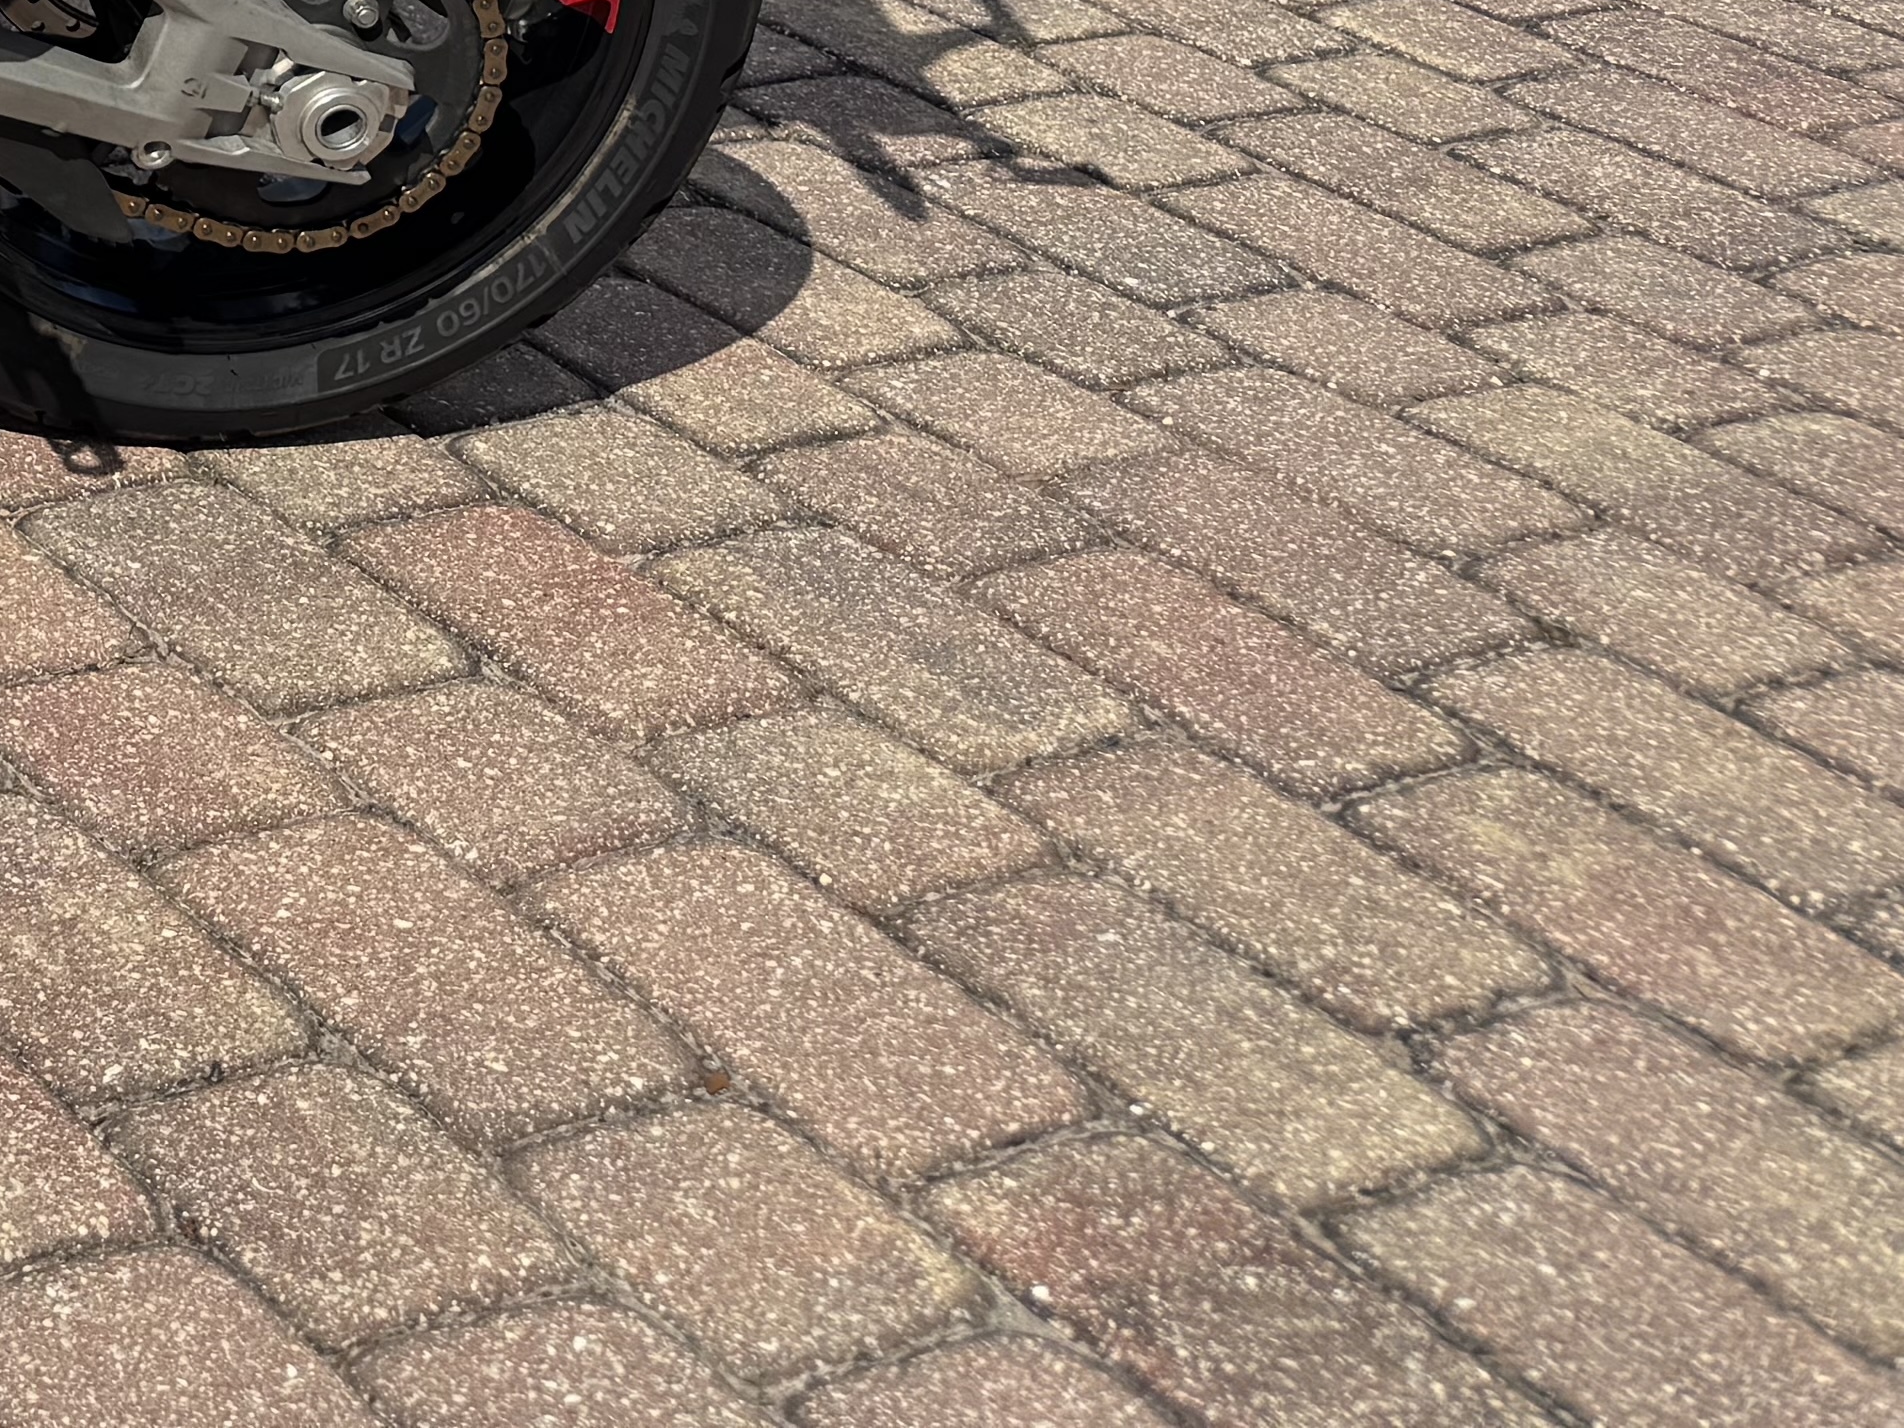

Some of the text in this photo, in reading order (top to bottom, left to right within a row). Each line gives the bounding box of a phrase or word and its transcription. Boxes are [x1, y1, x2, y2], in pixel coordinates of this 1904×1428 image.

[333, 43, 692, 382] MICHELIN 170/60 ZR 17
